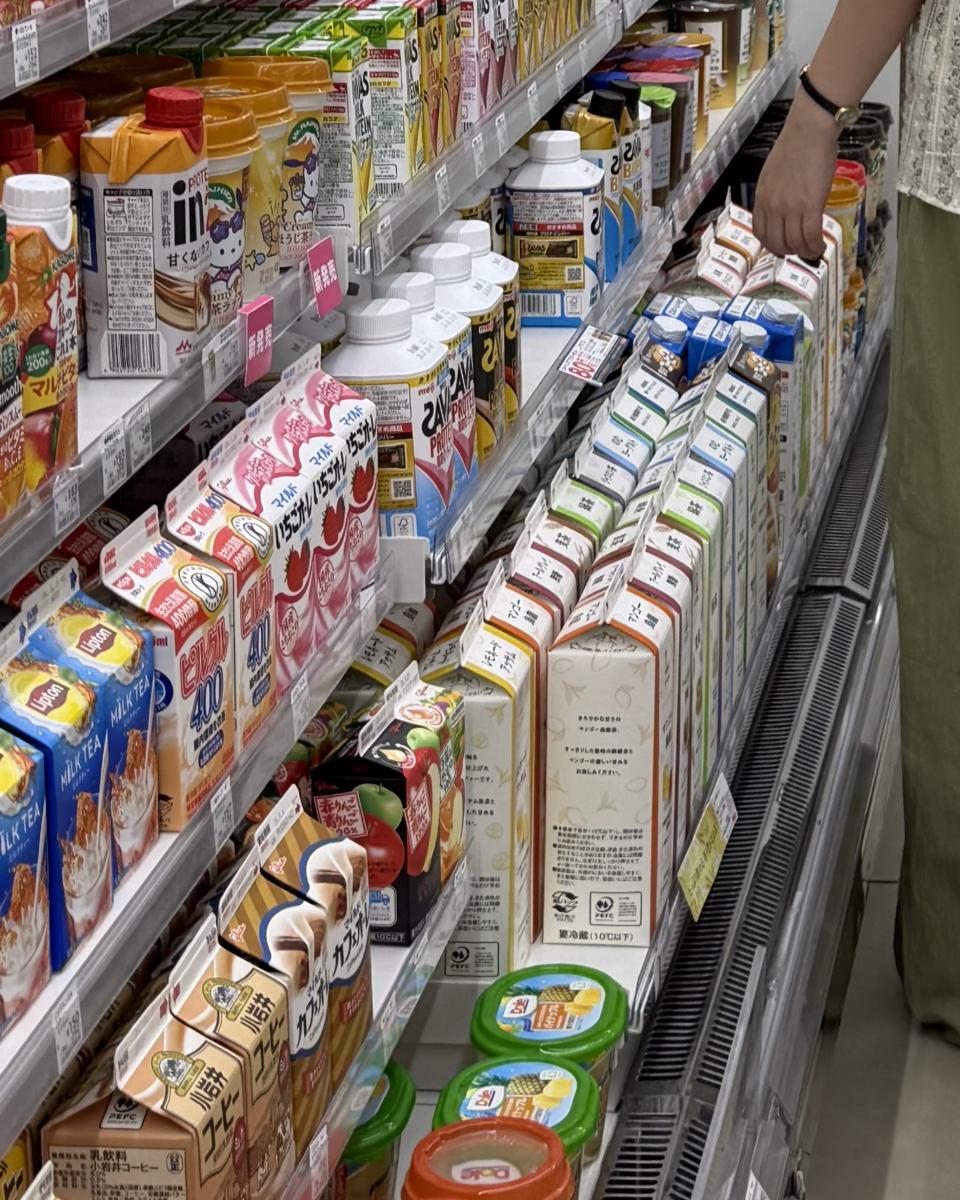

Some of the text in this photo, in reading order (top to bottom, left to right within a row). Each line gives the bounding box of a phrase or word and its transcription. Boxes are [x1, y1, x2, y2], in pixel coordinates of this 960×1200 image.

[312, 259, 338, 293] 新発売
[249, 324, 273, 360] 新発売
[340, 405, 366, 427] マイルド
[309, 442, 334, 467] マイルド
[271, 482, 299, 510] マイルド
[81, 627, 112, 655] Lipton
[246, 610, 271, 672] 400
[31, 684, 64, 712] Lipton
[133, 676, 150, 699] TEA
[190, 666, 224, 733] 400
[82, 735, 101, 760] TEA
[20, 802, 41, 826] TEA
[319, 796, 356, 814] 赤りんご
[324, 811, 357, 828] 青りんご
[240, 993, 276, 1034] 小岩井
[253, 1016, 285, 1083] コーヒー
[191, 1067, 228, 1112] 小岩井
[108, 1112, 137, 1121] PEFC
[202, 1090, 240, 1163] コーヒー
[90, 1151, 127, 1162] 乳飲料
[90, 1163, 159, 1173] 小岩井コーヒー
